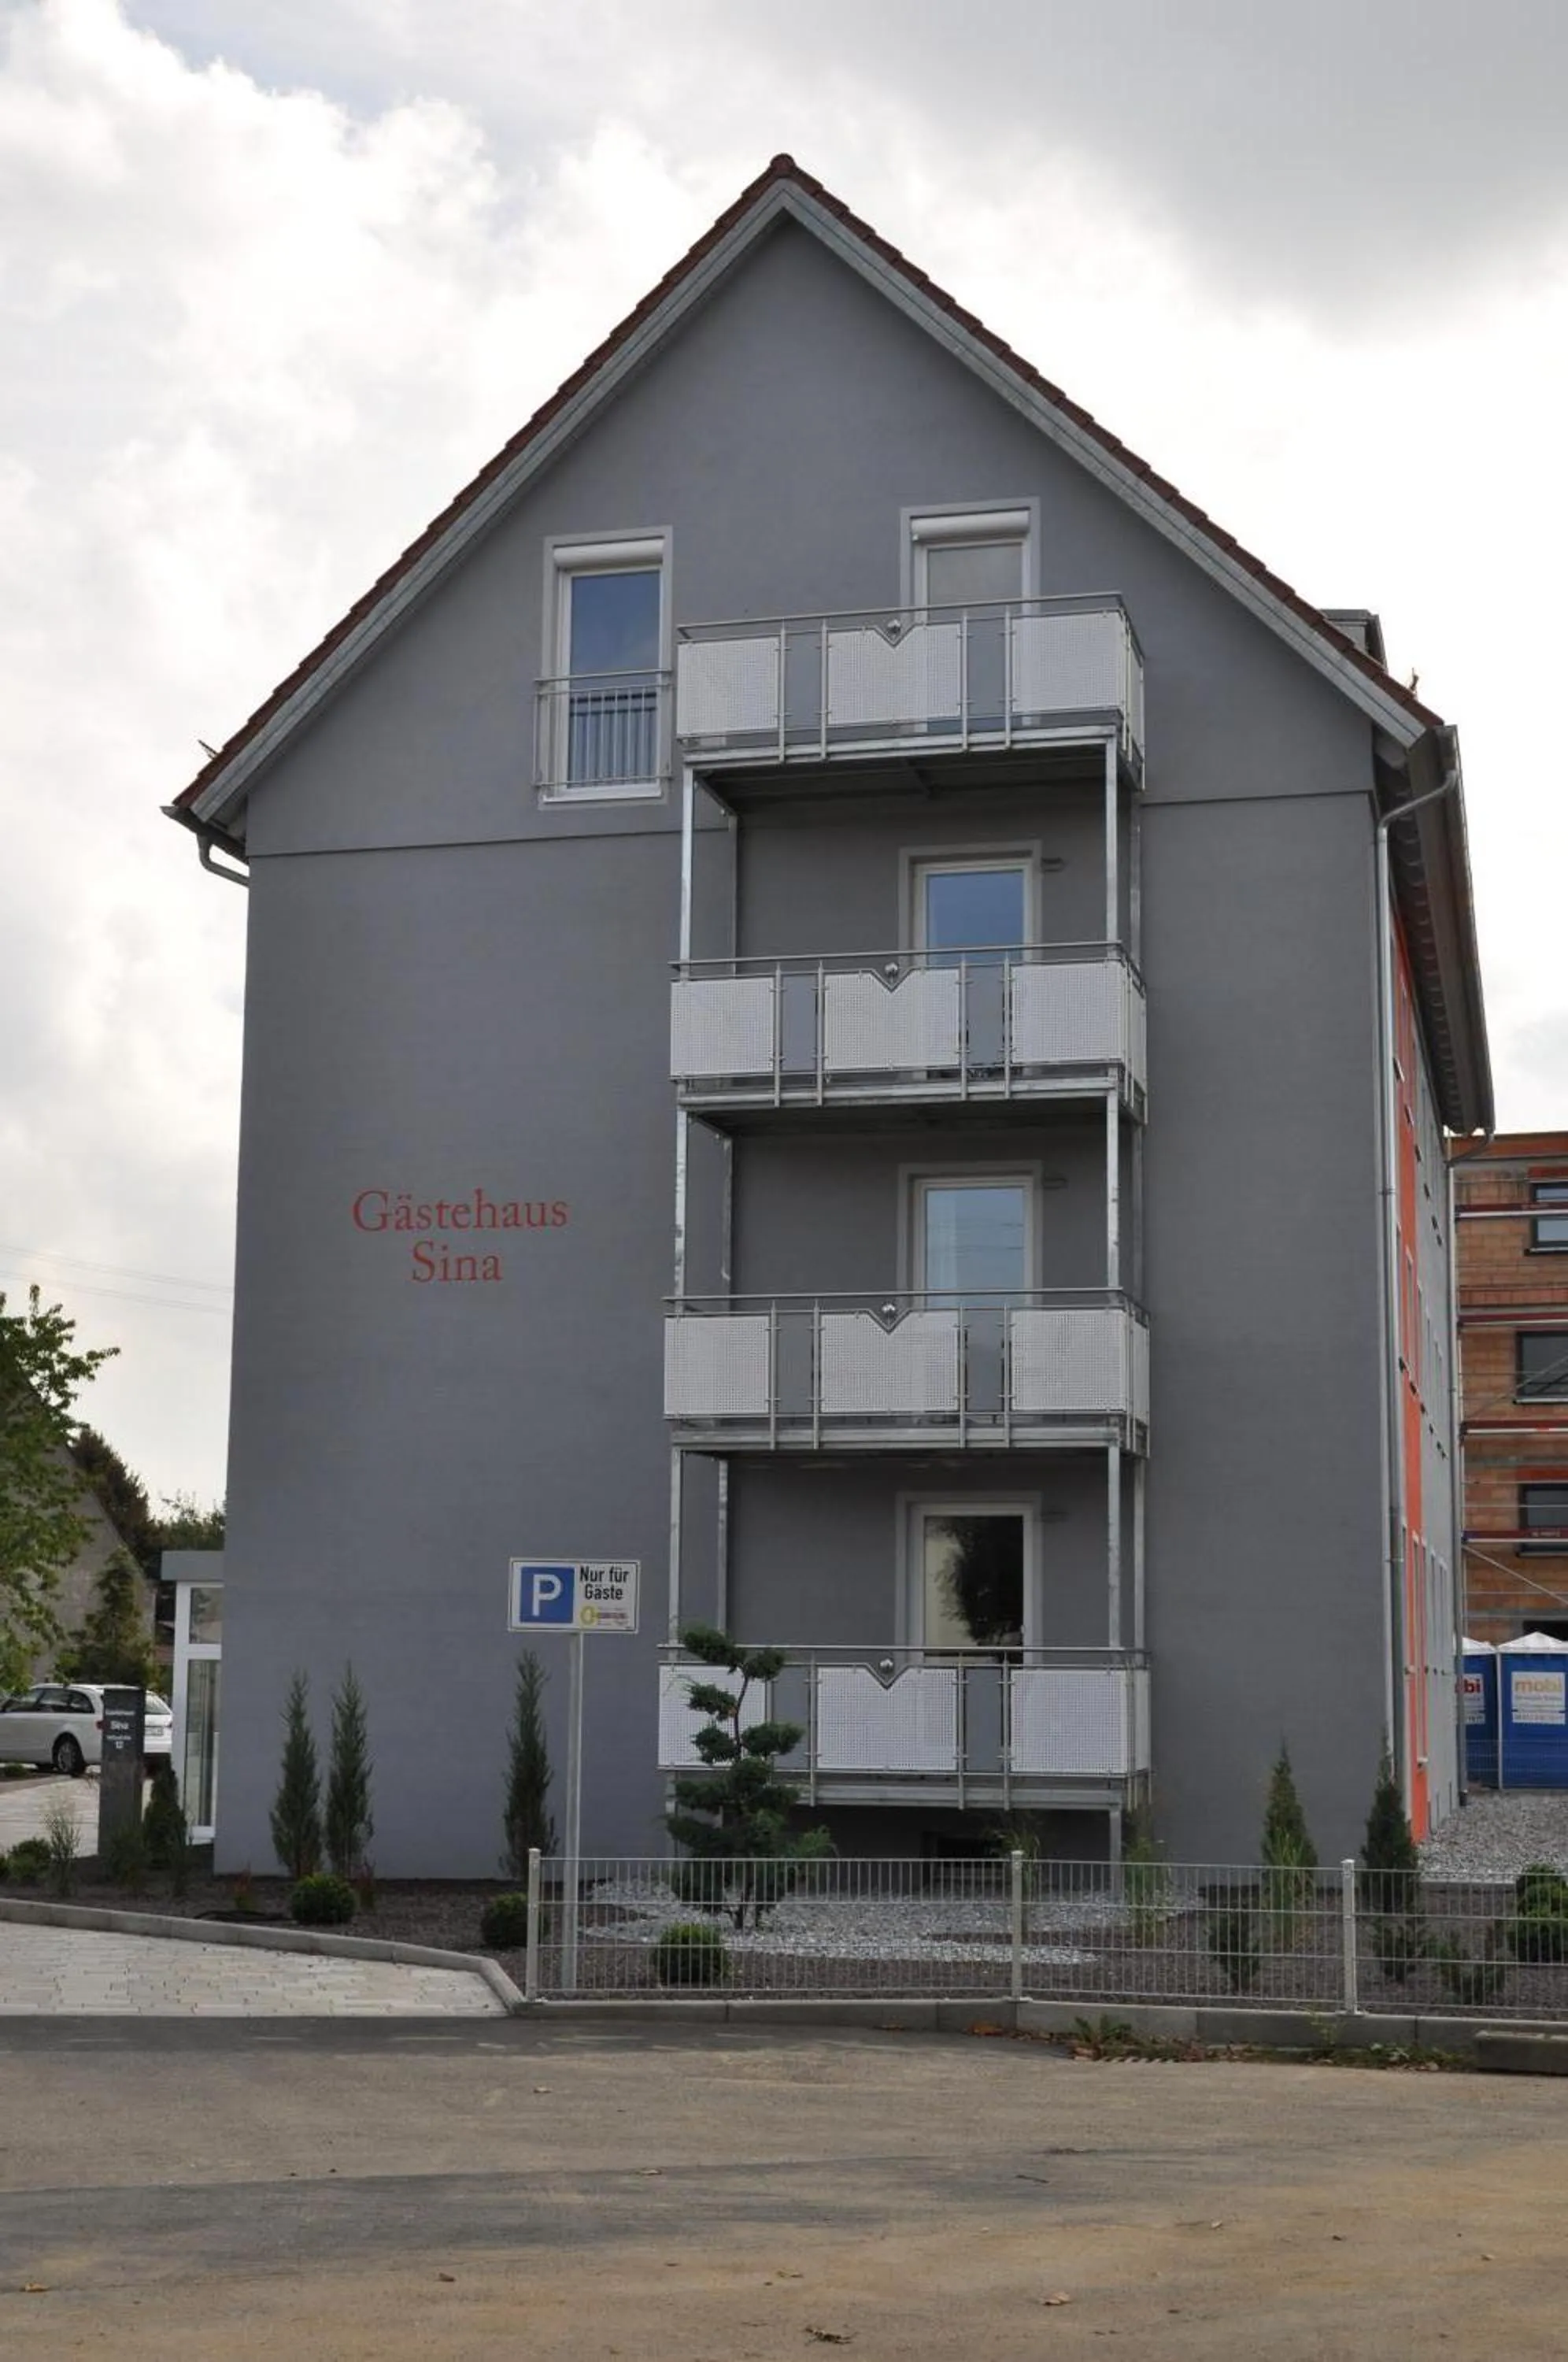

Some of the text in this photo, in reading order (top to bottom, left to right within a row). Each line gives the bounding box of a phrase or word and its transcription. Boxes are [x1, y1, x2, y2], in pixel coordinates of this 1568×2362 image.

[353, 1188, 569, 1231] Gästehaus
[412, 1241, 503, 1282] Sina
[579, 1565, 630, 1583] Nur für
[584, 1584, 623, 1600] Gäste
[533, 1574, 563, 1616] P
